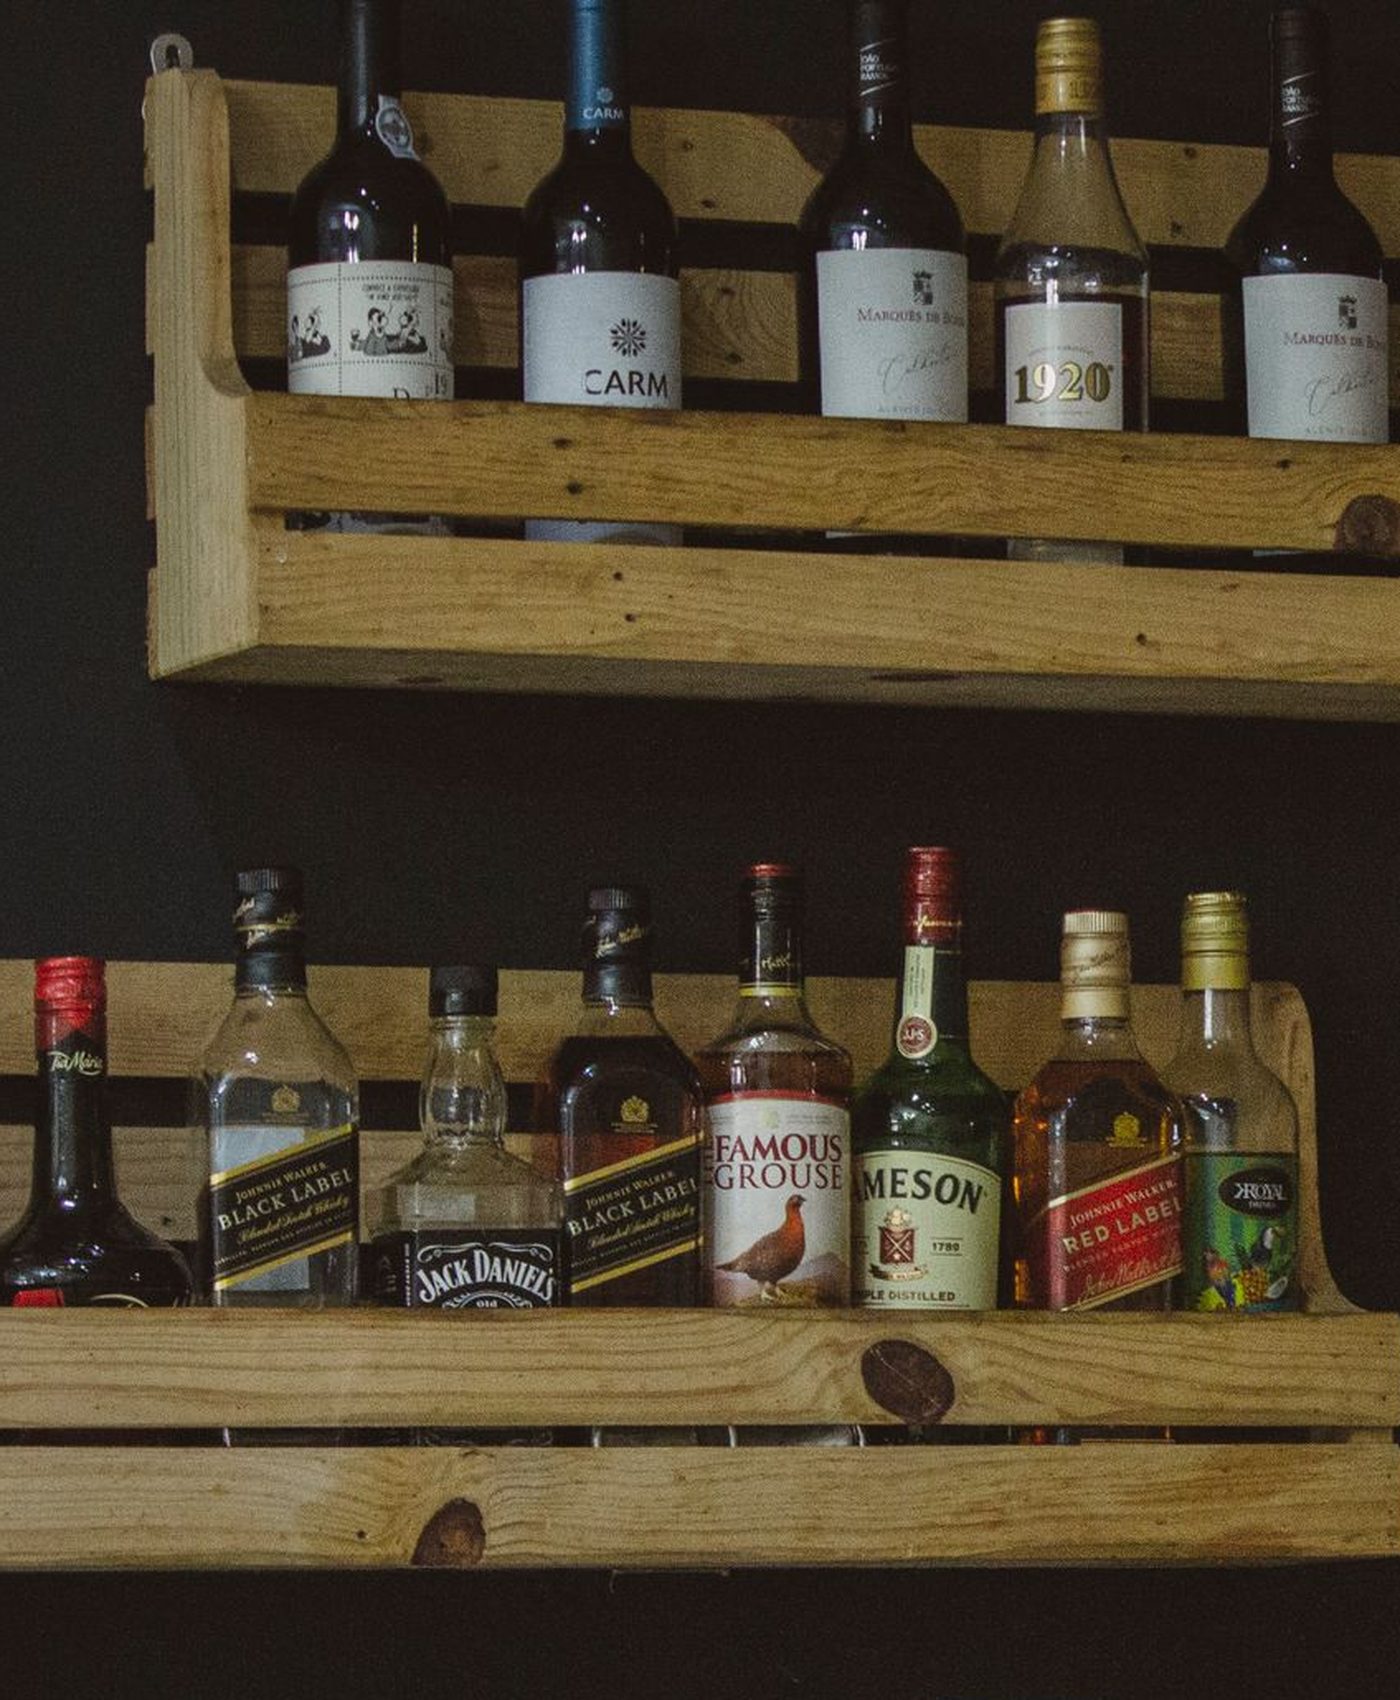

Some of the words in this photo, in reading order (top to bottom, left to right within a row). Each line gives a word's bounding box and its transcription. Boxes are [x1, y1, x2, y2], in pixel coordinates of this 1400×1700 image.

[582, 107, 625, 120] CARM
[585, 369, 668, 399] CARM
[1014, 361, 1110, 404] 1920
[714, 1133, 843, 1163] FAMOUS
[714, 1163, 843, 1190] GROUSE
[861, 1167, 983, 1214] MESON
[218, 1193, 287, 1232] BLACK
[290, 1168, 354, 1203] LABEL
[567, 1200, 635, 1237] BLACK
[1062, 1225, 1111, 1255] RED
[416, 1258, 474, 1304] JACK
[888, 1291, 957, 1302] DISTILLED
